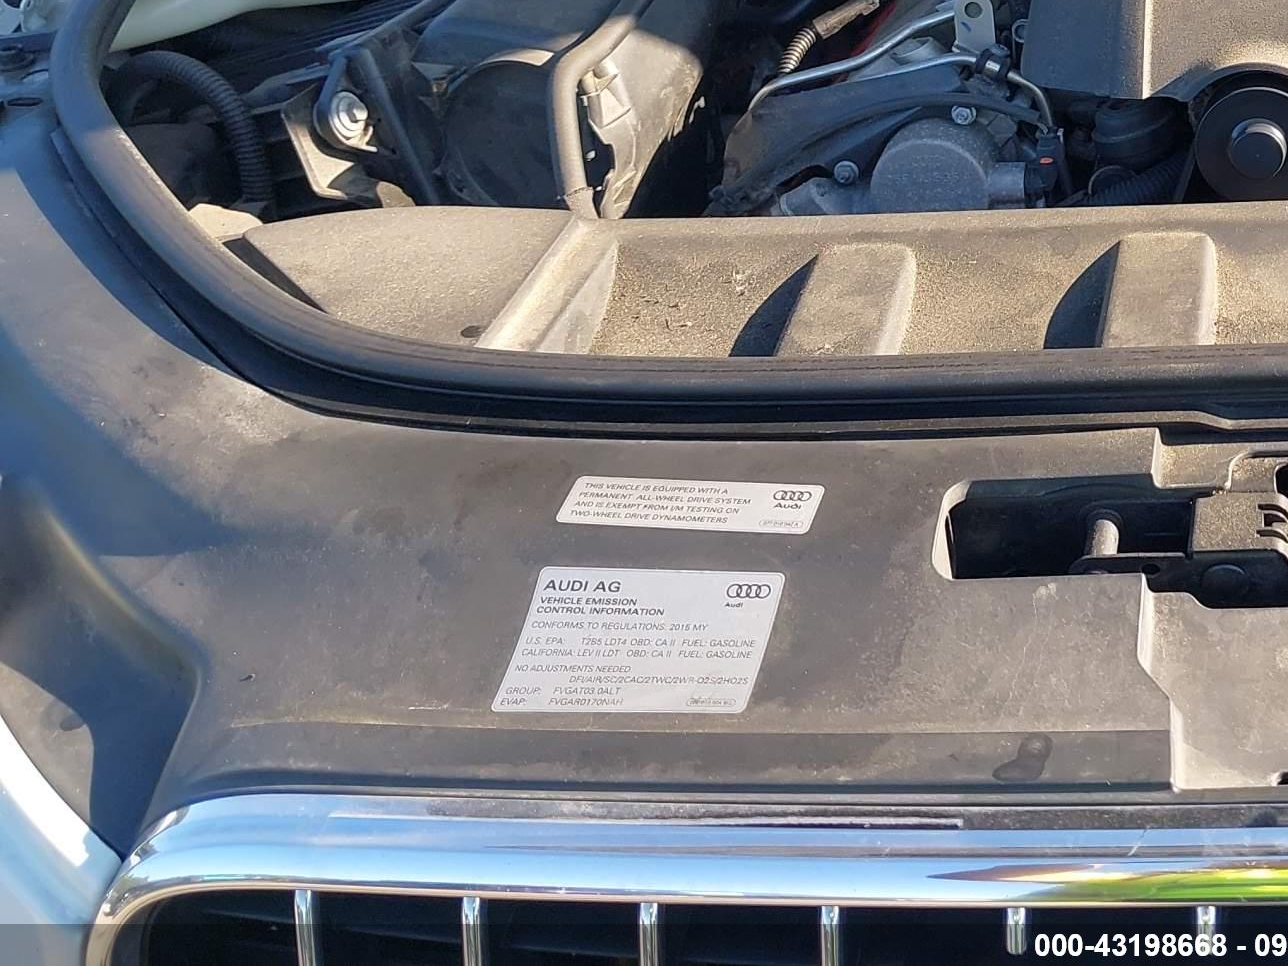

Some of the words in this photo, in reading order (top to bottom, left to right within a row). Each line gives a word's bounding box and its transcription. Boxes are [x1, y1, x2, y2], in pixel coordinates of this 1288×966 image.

[606, 483, 641, 491] VEHICLE
[653, 485, 696, 493] EQUIPPED
[579, 492, 633, 500] PERMANENT
[687, 496, 713, 504] DRIVE
[714, 497, 751, 505] SYSTEM
[571, 510, 622, 519] TWO-WHEEL
[651, 514, 728, 523] DYNAMOMETERS
[543, 579, 588, 592] AUDI
[593, 580, 621, 593] AG
[540, 596, 583, 605] VEHICLE
[585, 597, 638, 606] EMISSION
[536, 606, 586, 615] CONTROL
[589, 607, 665, 616] INFORMATION
[531, 620, 585, 630] CONFORMS
[587, 621, 599, 630] TO
[669, 623, 691, 632] 2015
[604, 638, 627, 646] LDT4
[630, 638, 653, 647] OBD:
[655, 639, 669, 647] CA
[681, 639, 708, 647] FUEL:
[709, 639, 757, 648] GASOLINE
[577, 648, 595, 657] LEV
[602, 649, 620, 657] LDT
[626, 649, 650, 658] OBD:
[651, 650, 665, 658] CA
[678, 650, 704, 658] FUEL:
[706, 650, 753, 659] GASOLINE
[515, 664, 528, 672] NO
[529, 664, 594, 673] ADJUSTMENTS
[500, 698, 528, 706] EVAP:
